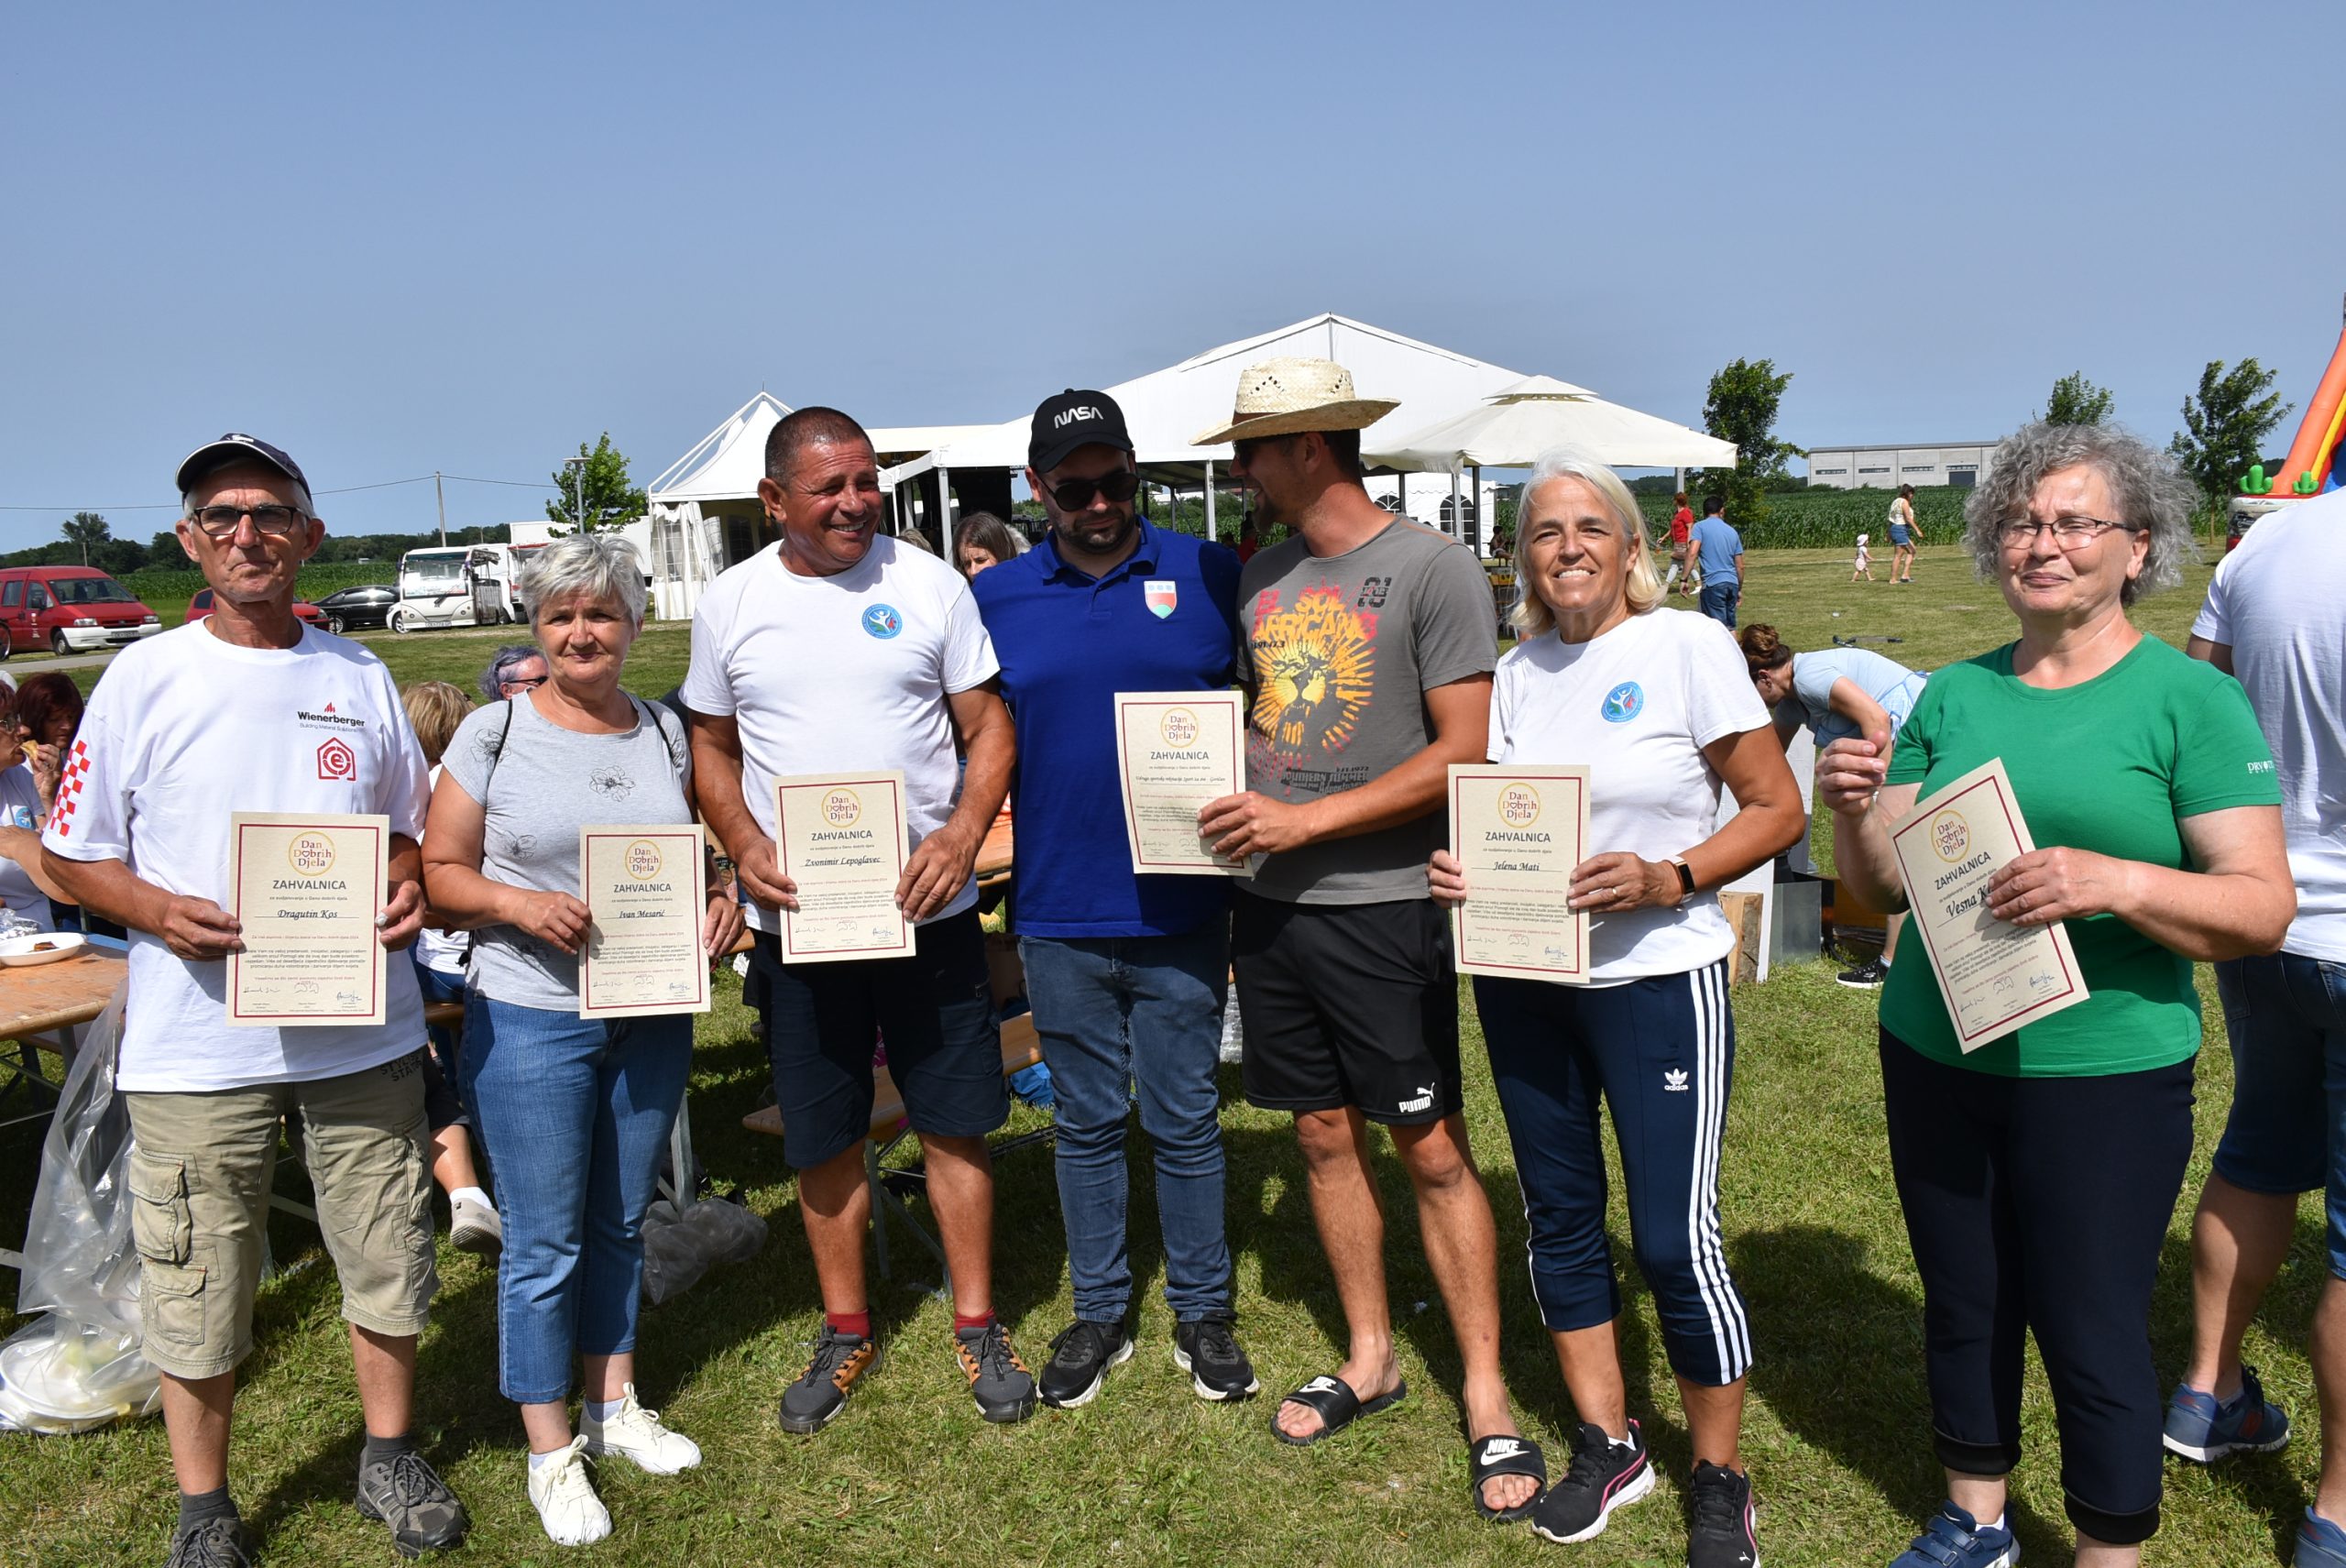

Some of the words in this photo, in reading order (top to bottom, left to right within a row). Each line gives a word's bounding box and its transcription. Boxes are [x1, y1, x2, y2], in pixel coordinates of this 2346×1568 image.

[1054, 406, 1103, 429] NASA
[1294, 587, 1346, 614] SOL
[297, 711, 365, 727] Wienerberger
[1168, 732, 1190, 740] Djela
[1151, 751, 1209, 760] ZAHVALNICA
[1509, 792, 1528, 800] Dan
[830, 812, 853, 821] Djela
[1507, 810, 1531, 820] Djela
[1937, 820, 1955, 835] Dan
[811, 830, 872, 841] ZAHVALNICA
[1485, 832, 1551, 842] ZAHVALNICA
[301, 840, 322, 849] Dan
[1943, 839, 1965, 855] Djela
[298, 859, 325, 869] Djela
[805, 857, 839, 867] Zvonimir
[841, 855, 881, 866] Lepoglavec
[1493, 861, 1517, 871] Jelena
[1519, 862, 1540, 872] Mati
[632, 864, 654, 873] Djela
[1935, 851, 1991, 890] ZAHVALNICA
[272, 880, 346, 890] ZAHVALNICA
[614, 883, 672, 893] ZAHVALNICA
[1946, 894, 1978, 917] Vesna
[277, 909, 318, 920] Dragutin
[321, 910, 338, 918] Kos
[637, 909, 665, 918] Mesarić
[1398, 1095, 1431, 1113] PUMA
[1486, 1439, 1519, 1454] NIKE
